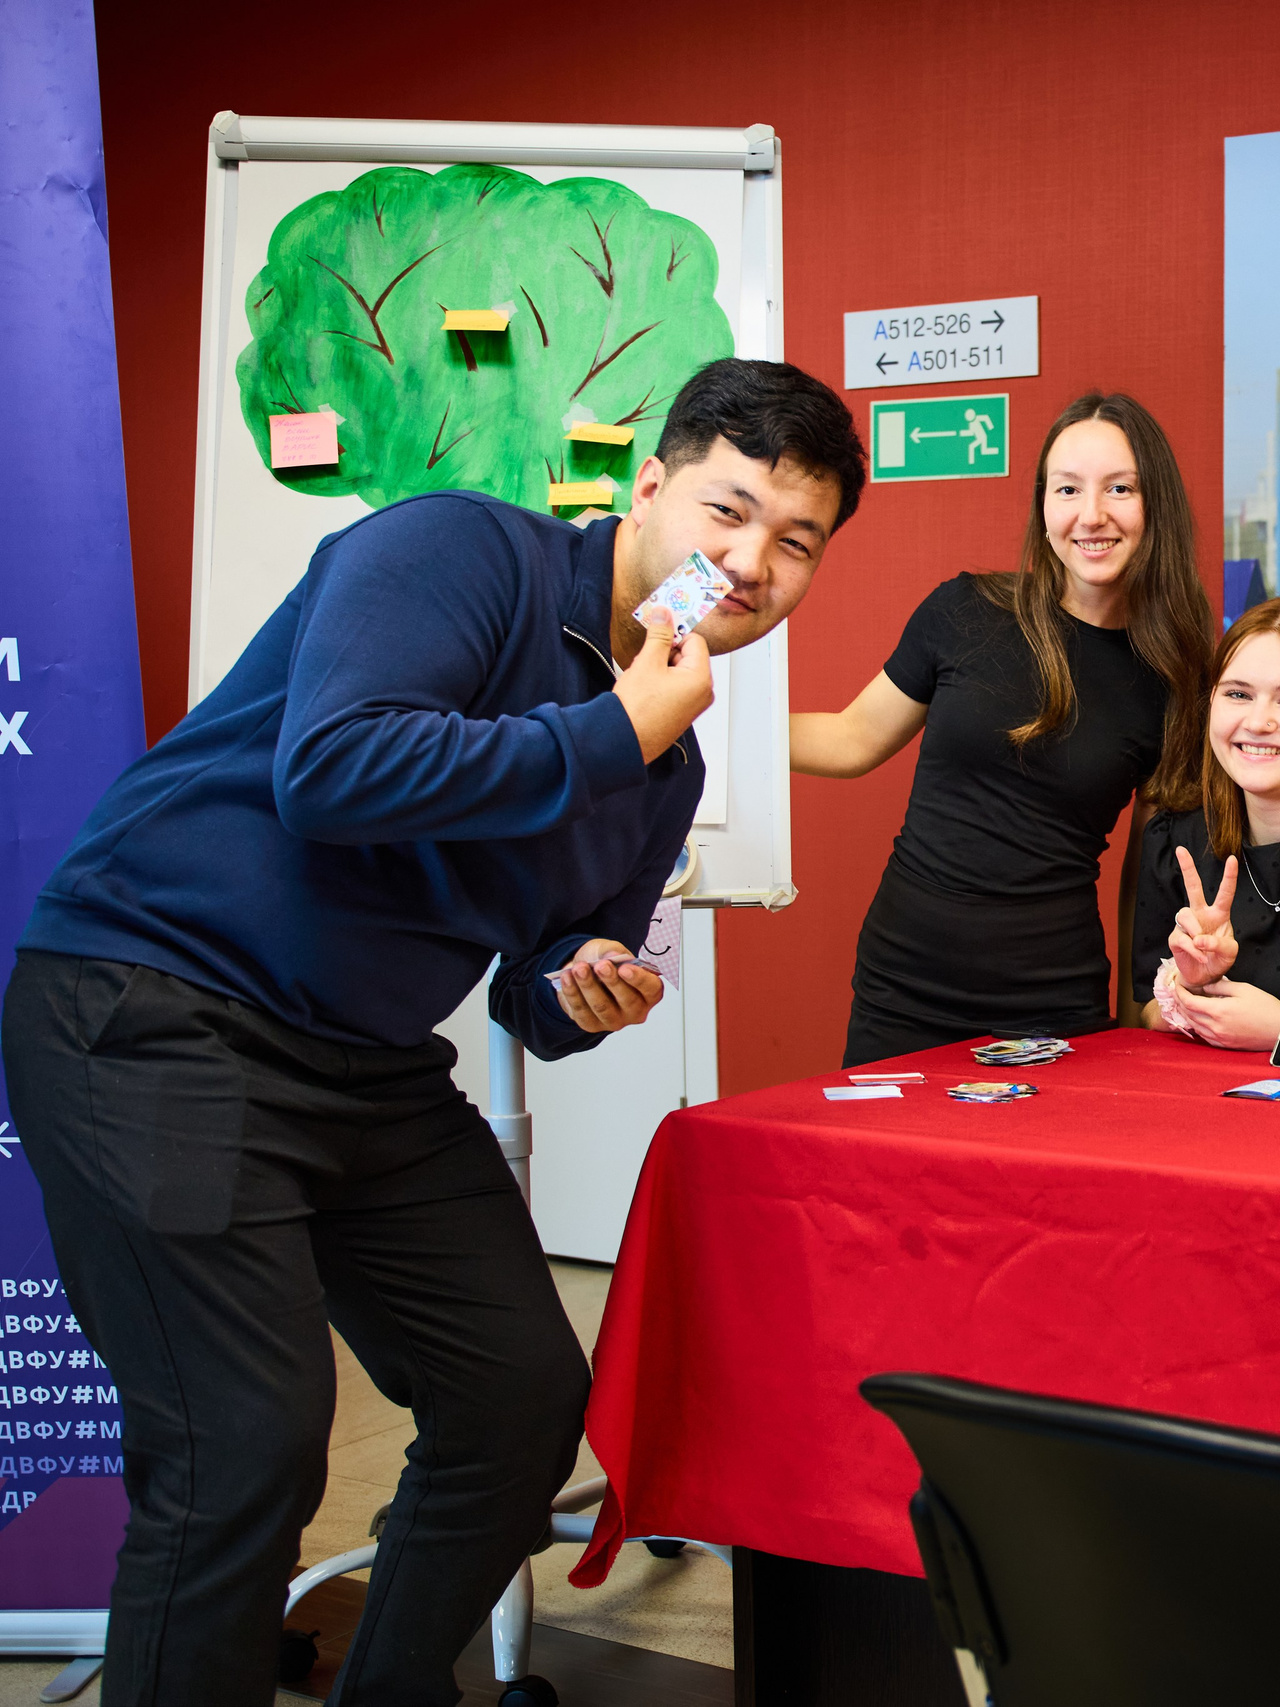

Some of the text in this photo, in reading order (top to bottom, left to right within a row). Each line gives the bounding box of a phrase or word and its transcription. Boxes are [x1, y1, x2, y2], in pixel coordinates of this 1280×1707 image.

[874, 313, 971, 341] A512-526
[907, 345, 1003, 372] A501-511
[0, 1314, 82, 1338] ВФУ#
